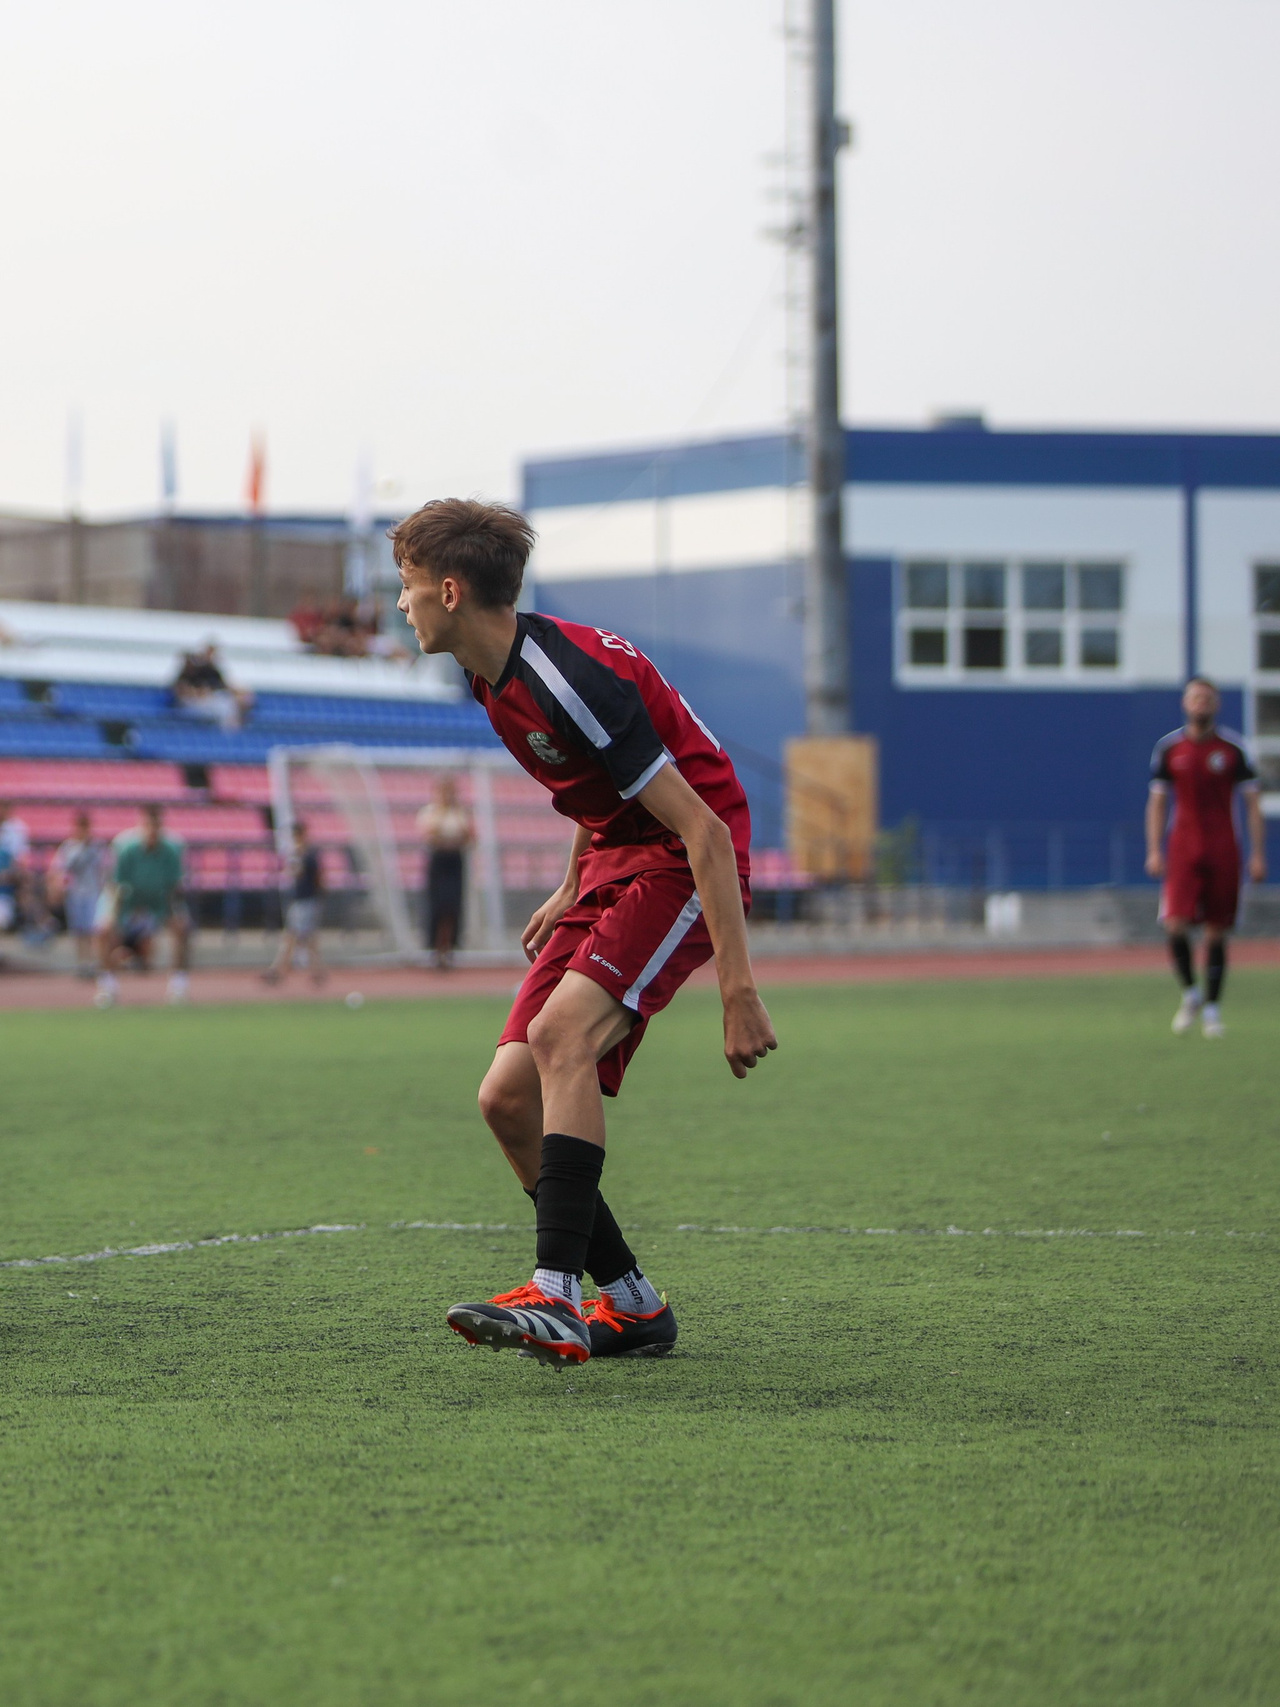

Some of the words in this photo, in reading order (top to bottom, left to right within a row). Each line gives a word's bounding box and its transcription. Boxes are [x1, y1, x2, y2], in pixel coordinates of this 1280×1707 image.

[600, 959, 623, 977] SPORT
[562, 1273, 573, 1301] ESIGN
[623, 1272, 644, 1305] DESIGN
